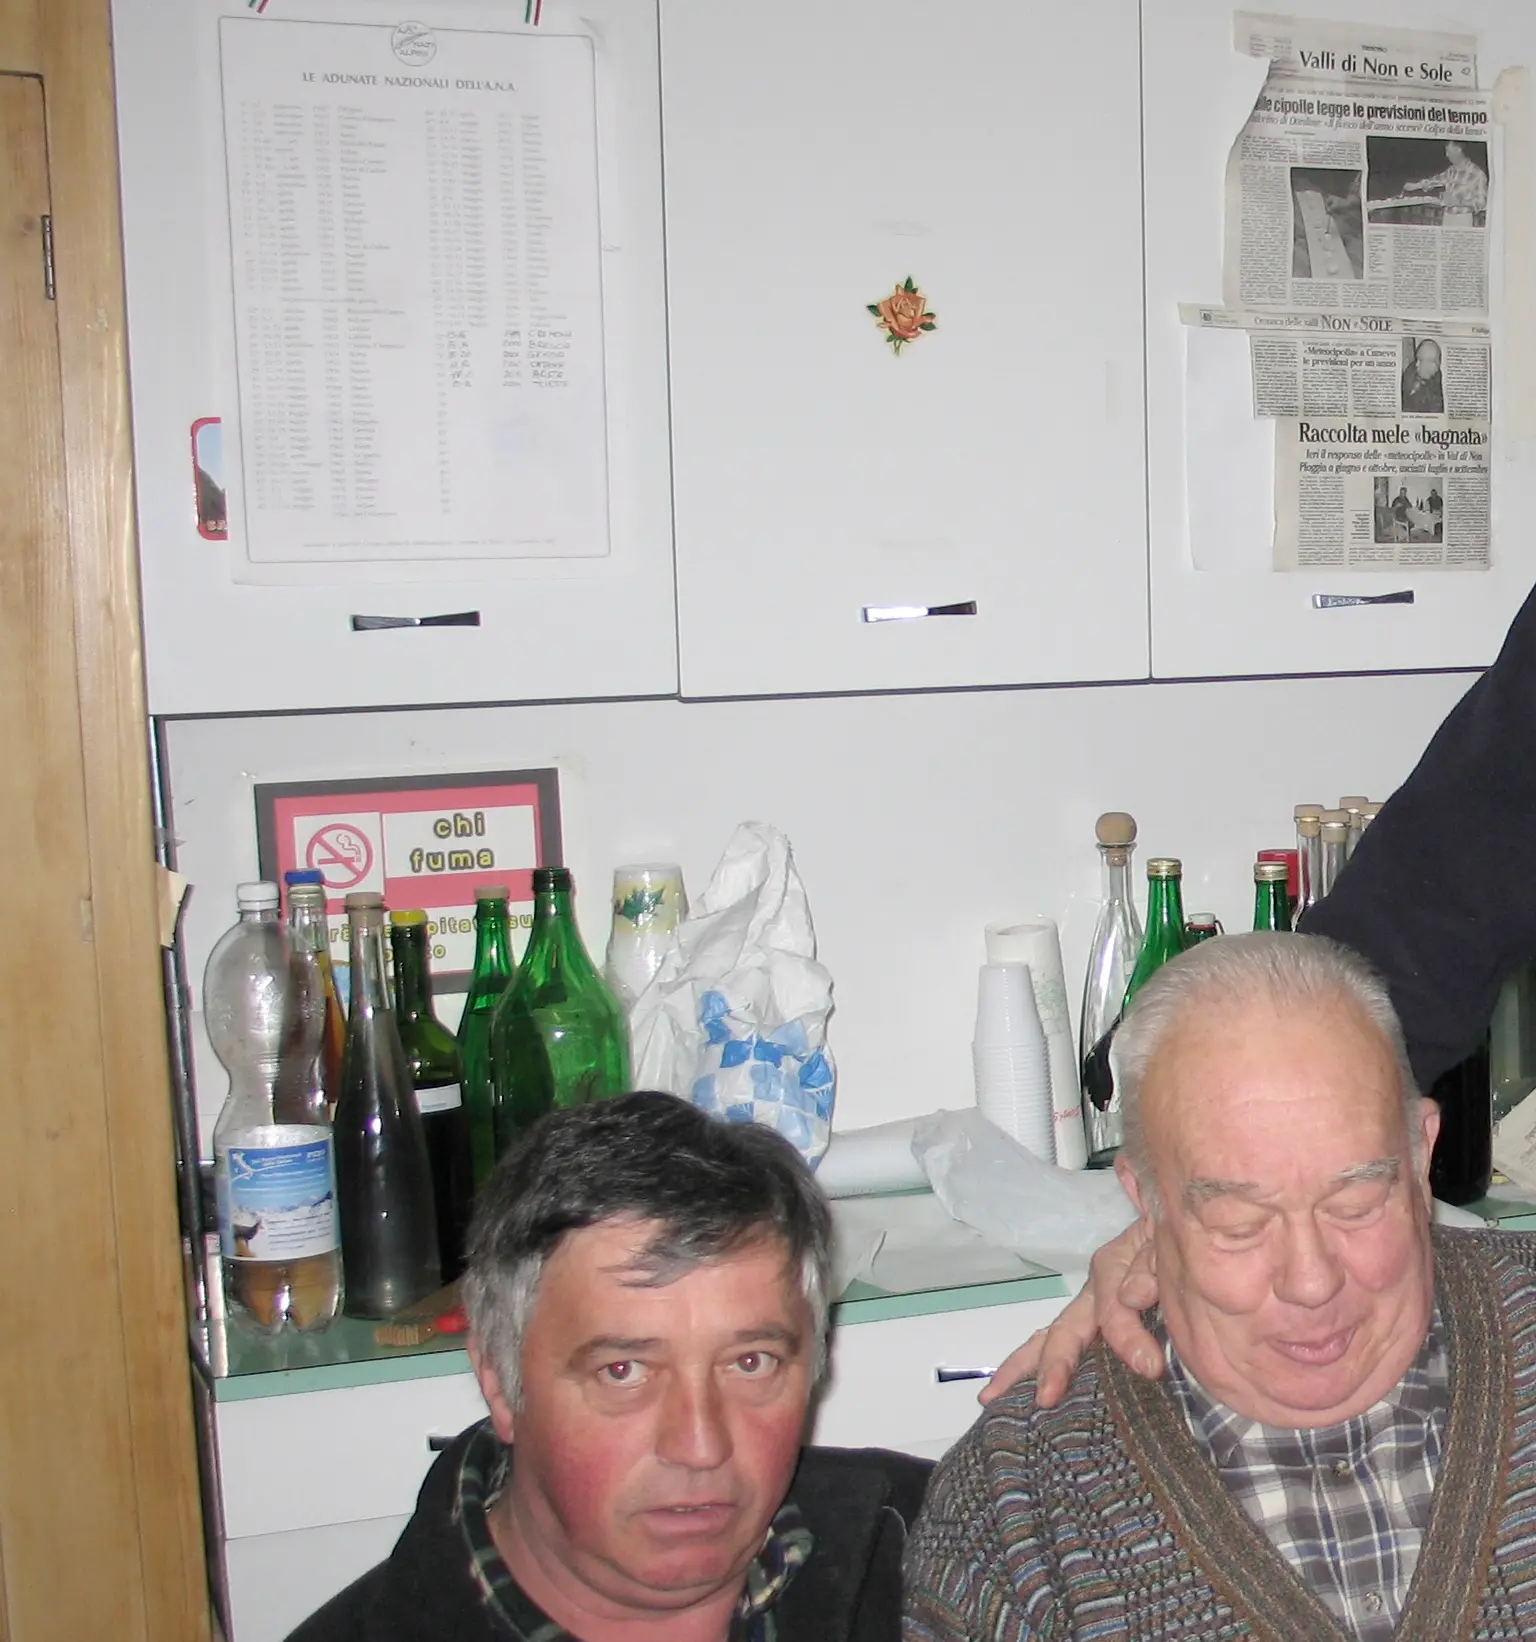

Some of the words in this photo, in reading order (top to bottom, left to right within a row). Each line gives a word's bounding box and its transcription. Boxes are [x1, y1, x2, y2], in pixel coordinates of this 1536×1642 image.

[1299, 49, 1336, 71] Valli
[1341, 54, 1357, 73] di
[1363, 57, 1399, 77] Non
[1404, 64, 1415, 78] e
[1419, 62, 1453, 83] Sole
[302, 72, 316, 83] LE
[321, 73, 378, 86] ADUNATE
[384, 76, 450, 90] NAZIONALI
[1273, 97, 1314, 116] cipolle
[1316, 99, 1351, 118] legge
[1353, 102, 1365, 118] le
[1367, 104, 1426, 122] previsioni
[1427, 106, 1446, 121] del
[1449, 109, 1488, 126] tempo
[1350, 360, 1363, 368] per
[1299, 422, 1369, 444] Raccolta
[1372, 424, 1411, 444] mele
[1414, 425, 1488, 450] «bagnata»
[1306, 449, 1320, 459] Ieri
[1327, 450, 1363, 462] responso
[1363, 449, 1382, 459] delle
[1459, 450, 1468, 460] di
[1299, 462, 1327, 474] Pioggia
[1328, 465, 1334, 473] a
[1334, 463, 1361, 475] giugno
[1362, 465, 1367, 473] e
[433, 812, 485, 838] chi
[410, 848, 494, 873] fuma
